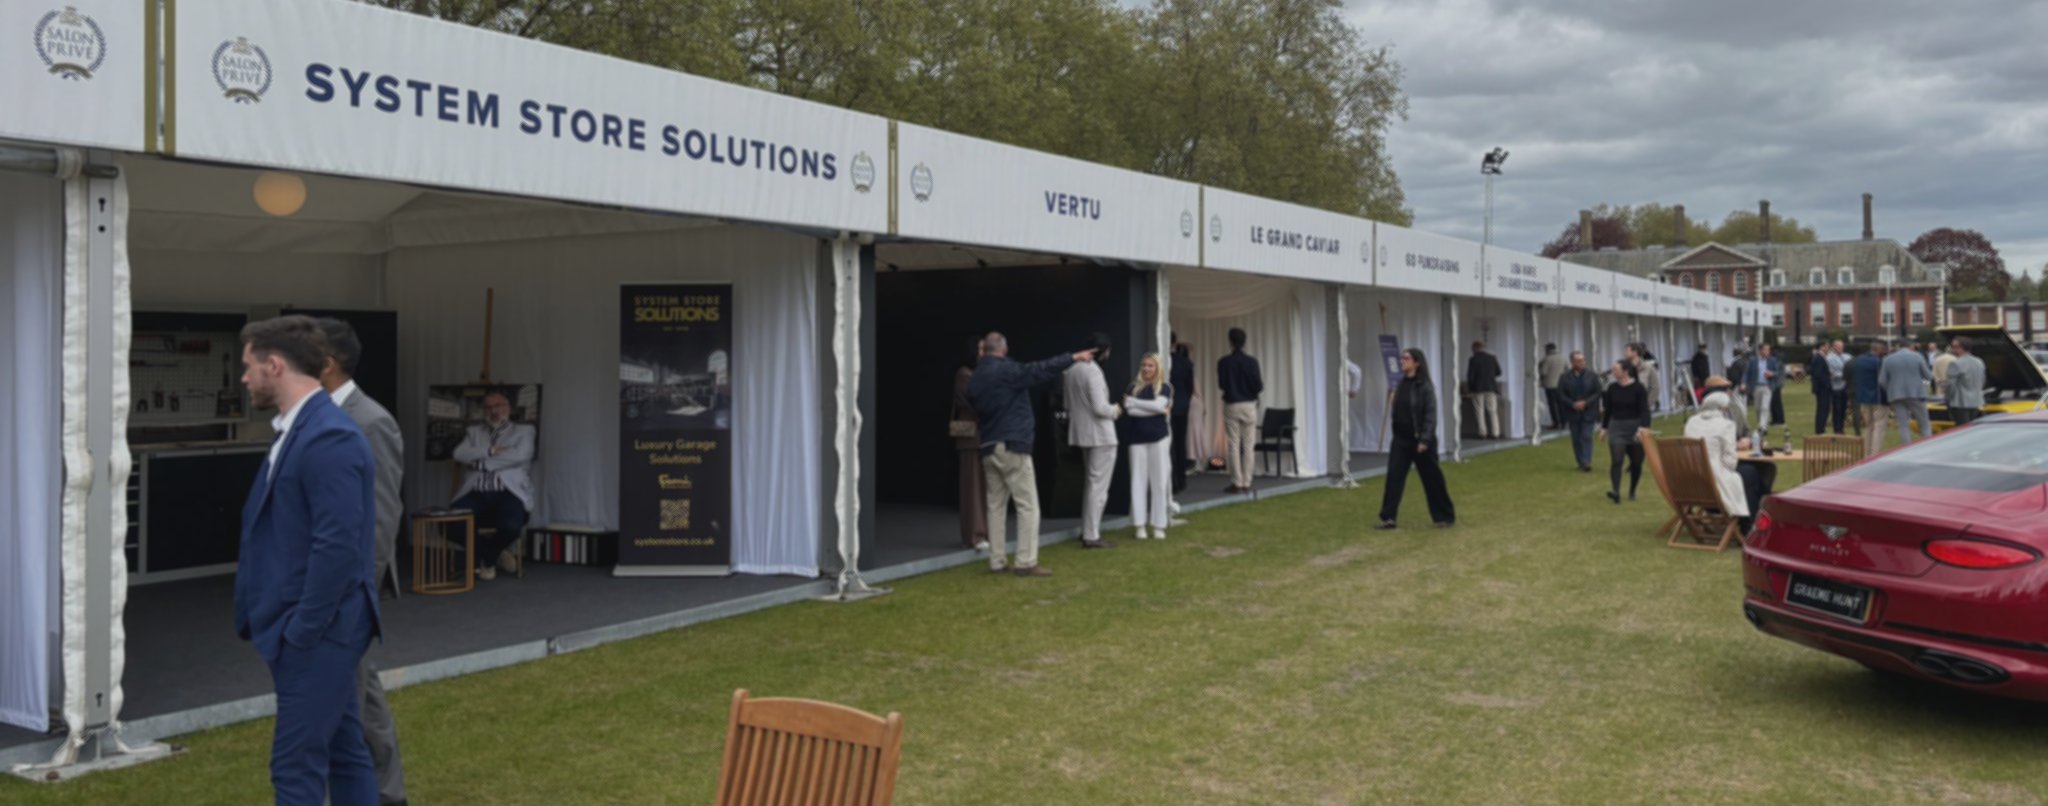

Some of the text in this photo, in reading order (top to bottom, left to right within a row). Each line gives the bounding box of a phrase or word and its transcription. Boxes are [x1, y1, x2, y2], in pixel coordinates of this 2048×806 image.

[47, 26, 94, 45] SALON
[305, 62, 838, 181] SYSTEM STORE SOLUTIONS
[1044, 190, 1101, 221] VERTU
[1250, 226, 1341, 255] LE GRAND CAVIAR
[633, 295, 720, 305] SYSTEM STORE
[634, 306, 721, 322] SOLUTIONS
[634, 438, 717, 451] Luxury Garage
[649, 453, 702, 464] Solutions
[1793, 582, 1861, 610] GRAEME HUNT
